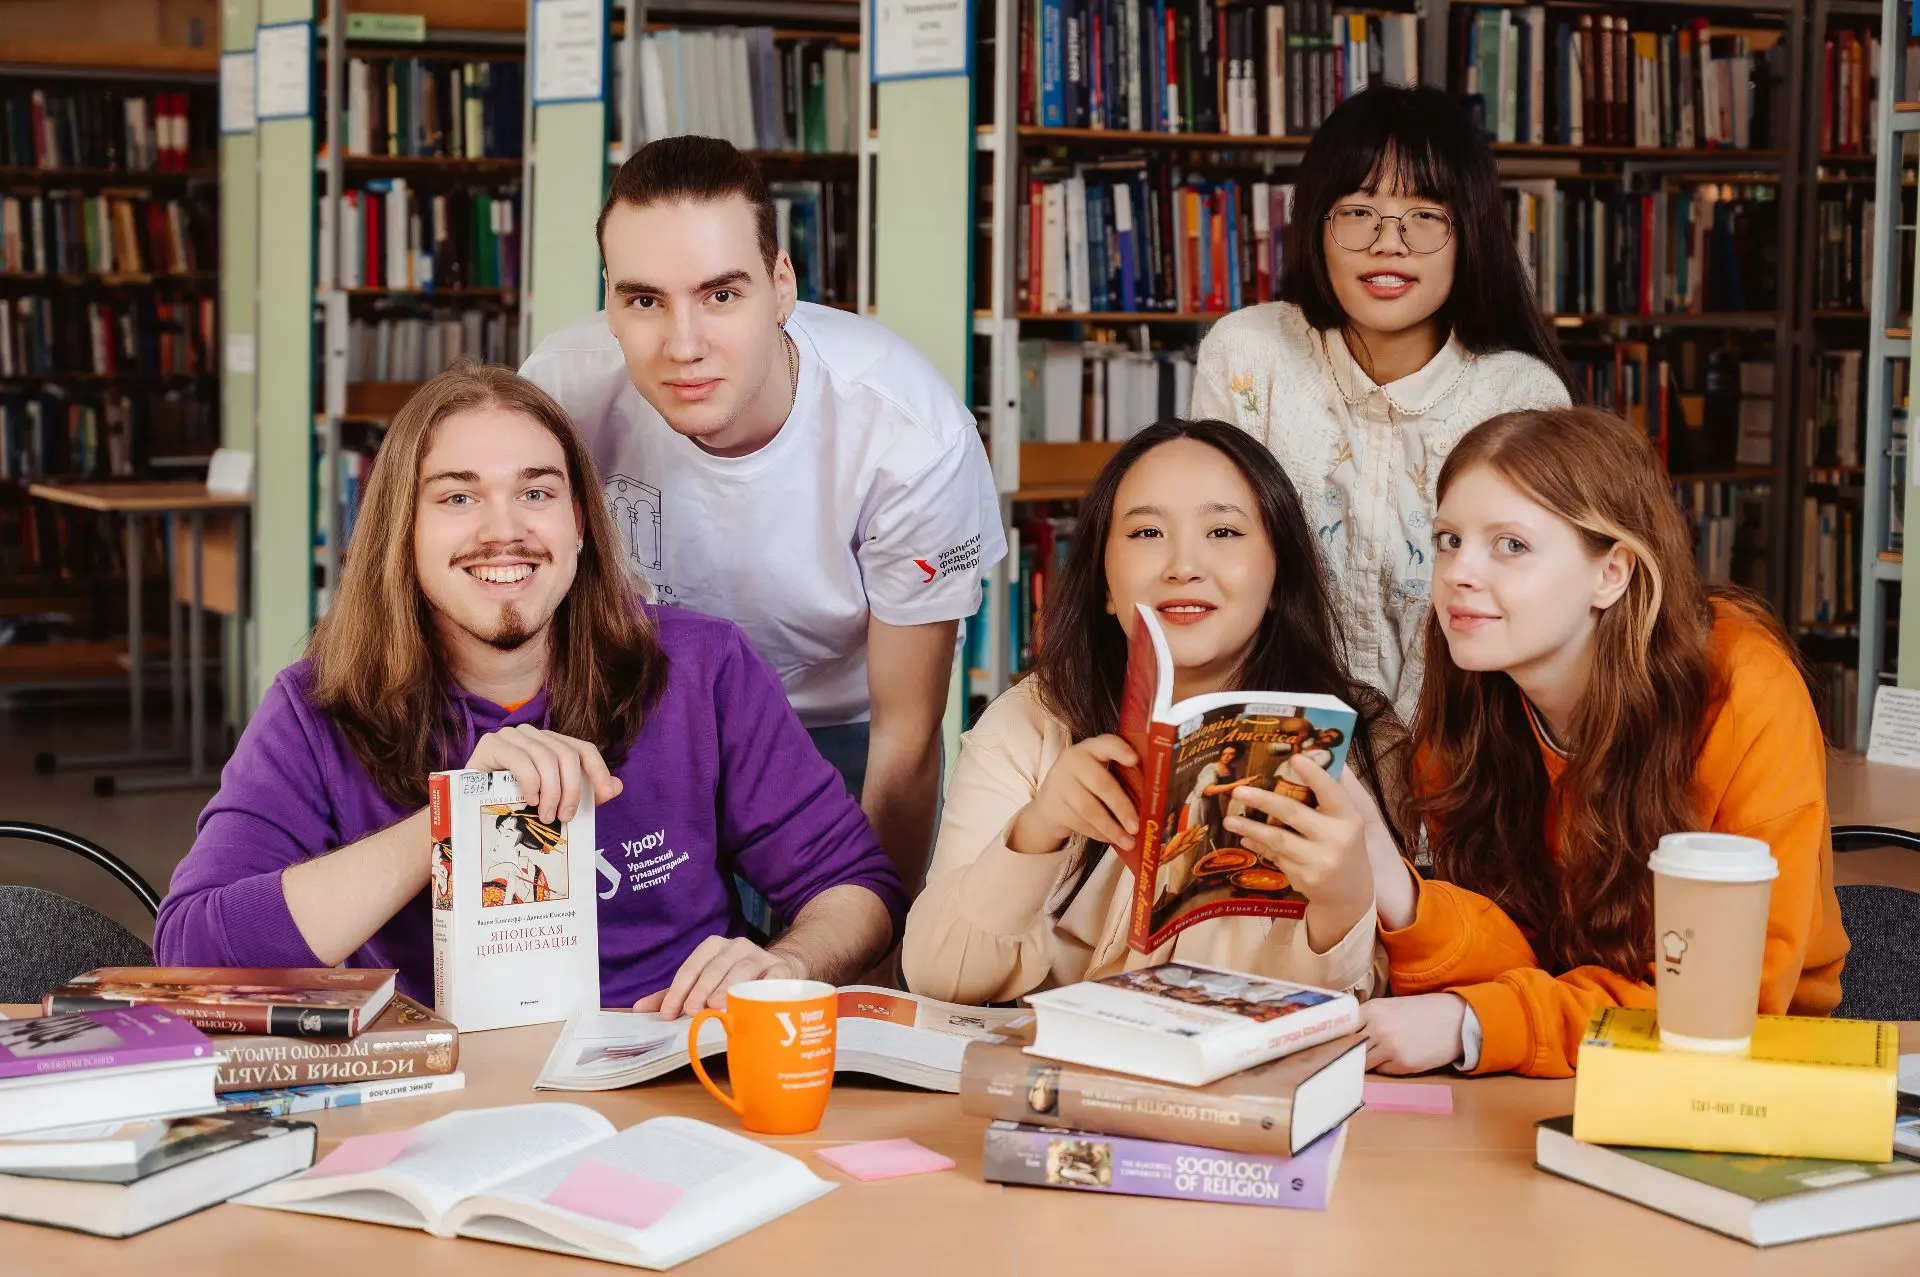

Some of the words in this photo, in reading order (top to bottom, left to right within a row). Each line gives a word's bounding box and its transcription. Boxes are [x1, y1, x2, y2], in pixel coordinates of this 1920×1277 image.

[1178, 736, 1219, 764] Latin
[1217, 728, 1299, 745] America
[621, 829, 665, 858] УрФУ
[627, 849, 674, 872] Уральский
[629, 851, 690, 882] гуманитарный
[632, 873, 671, 892] институт
[491, 924, 563, 941] ЯПОНСКАЯ
[476, 935, 578, 957] ЦИВИЛИЗАЦИЯ
[225, 1046, 287, 1063] НАРОДА
[291, 1042, 369, 1061] РУССКОГО
[307, 1058, 414, 1080] ИСТОРИЯ
[369, 1088, 407, 1098] ВИЗГАЛОВ
[408, 1082, 434, 1092] ДЕНИС
[1136, 1099, 1197, 1119] RELIGIOUS
[1176, 1156, 1273, 1181] SOCIOLOGY
[1175, 1174, 1199, 1192] OF
[1203, 1177, 1280, 1200] RELIGION
